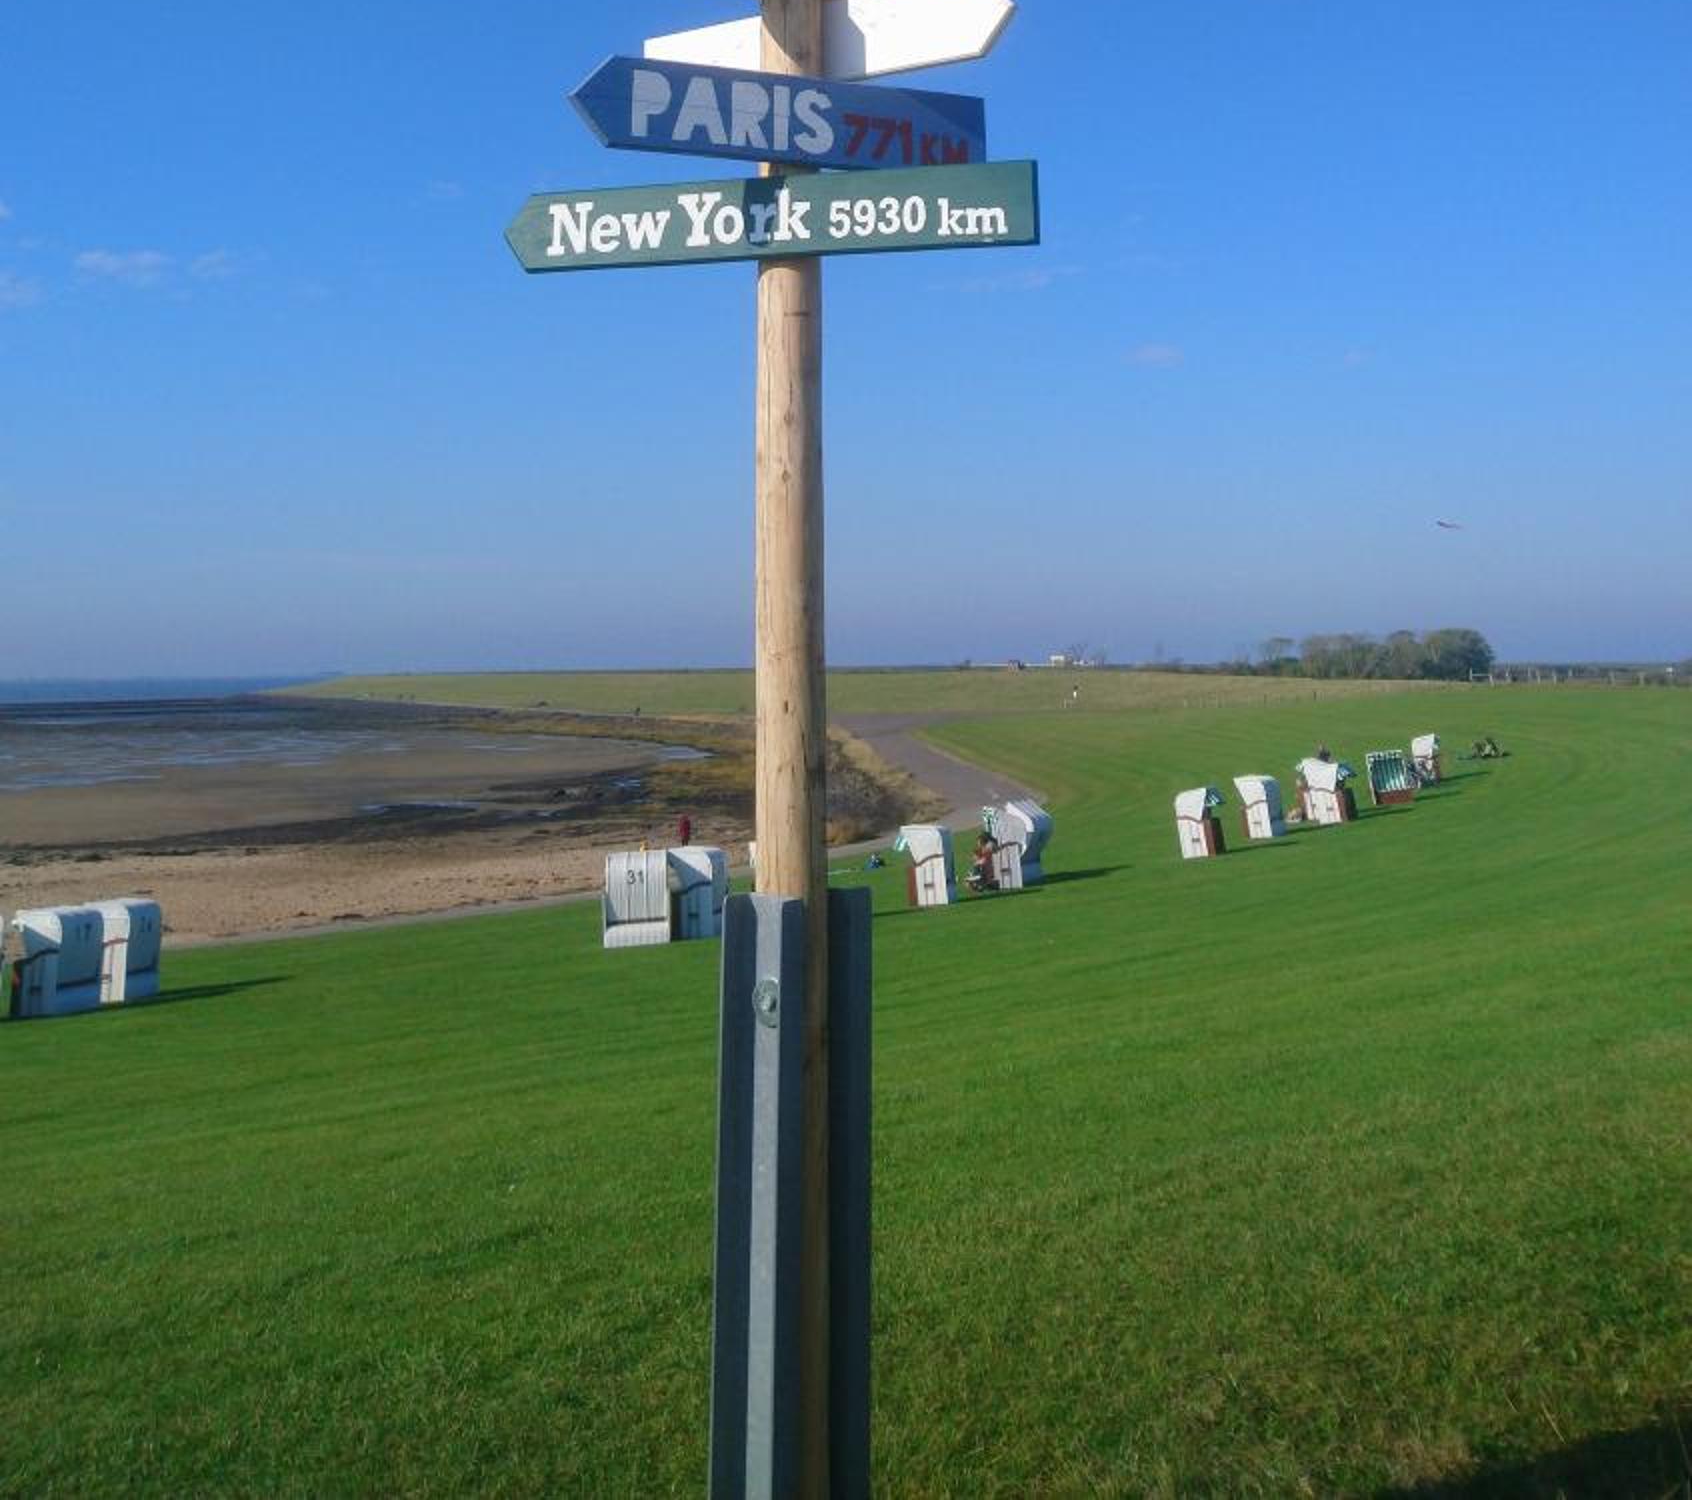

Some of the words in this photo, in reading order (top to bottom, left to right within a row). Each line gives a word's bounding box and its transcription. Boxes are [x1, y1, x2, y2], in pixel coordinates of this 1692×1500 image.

[630, 69, 836, 154] PARIS
[842, 113, 914, 165] 771
[920, 132, 970, 166] KM
[547, 201, 672, 257] New
[678, 184, 812, 248] York
[828, 196, 926, 239] 5930
[937, 197, 1009, 236] km
[626, 869, 645, 885] 31
